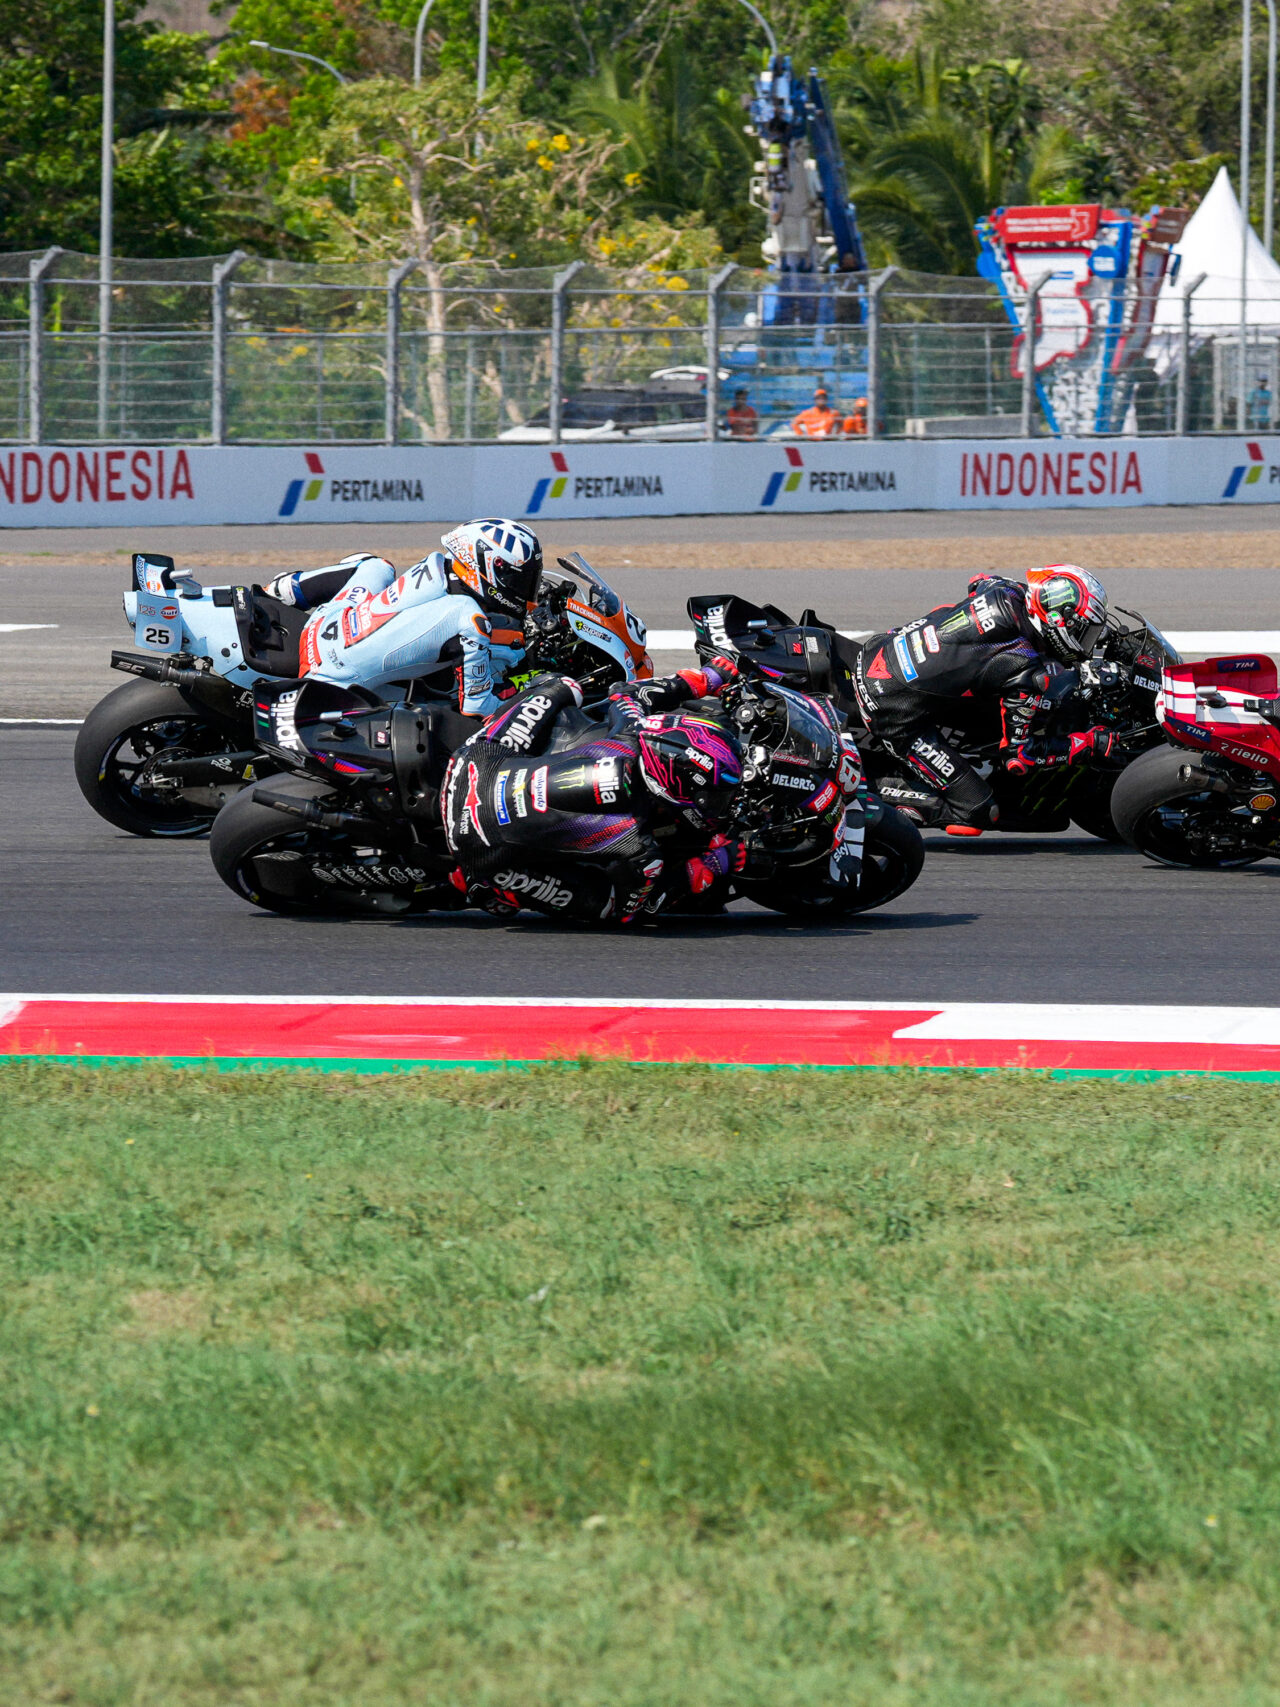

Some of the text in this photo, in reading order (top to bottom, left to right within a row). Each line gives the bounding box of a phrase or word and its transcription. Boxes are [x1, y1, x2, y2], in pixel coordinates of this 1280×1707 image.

[0, 449, 194, 504] NDONESIA
[809, 471, 896, 492] PERTAMINA
[960, 451, 1143, 497] INDONESIA
[331, 479, 424, 502] PERTAMINA
[575, 476, 663, 499] PERTAMINA
[970, 594, 996, 632] prilia
[146, 627, 170, 645] 25
[857, 651, 878, 711] DAINESE
[1134, 675, 1163, 693] DELLOR
[1186, 725, 1207, 737] TIM
[684, 747, 714, 771] aprilia
[911, 738, 955, 777] aprilia
[1231, 747, 1269, 764] riello
[772, 773, 815, 791] DELLORTO
[880, 786, 930, 800] DAINESE
[833, 842, 849, 862] sky
[493, 868, 573, 908] aprilia
